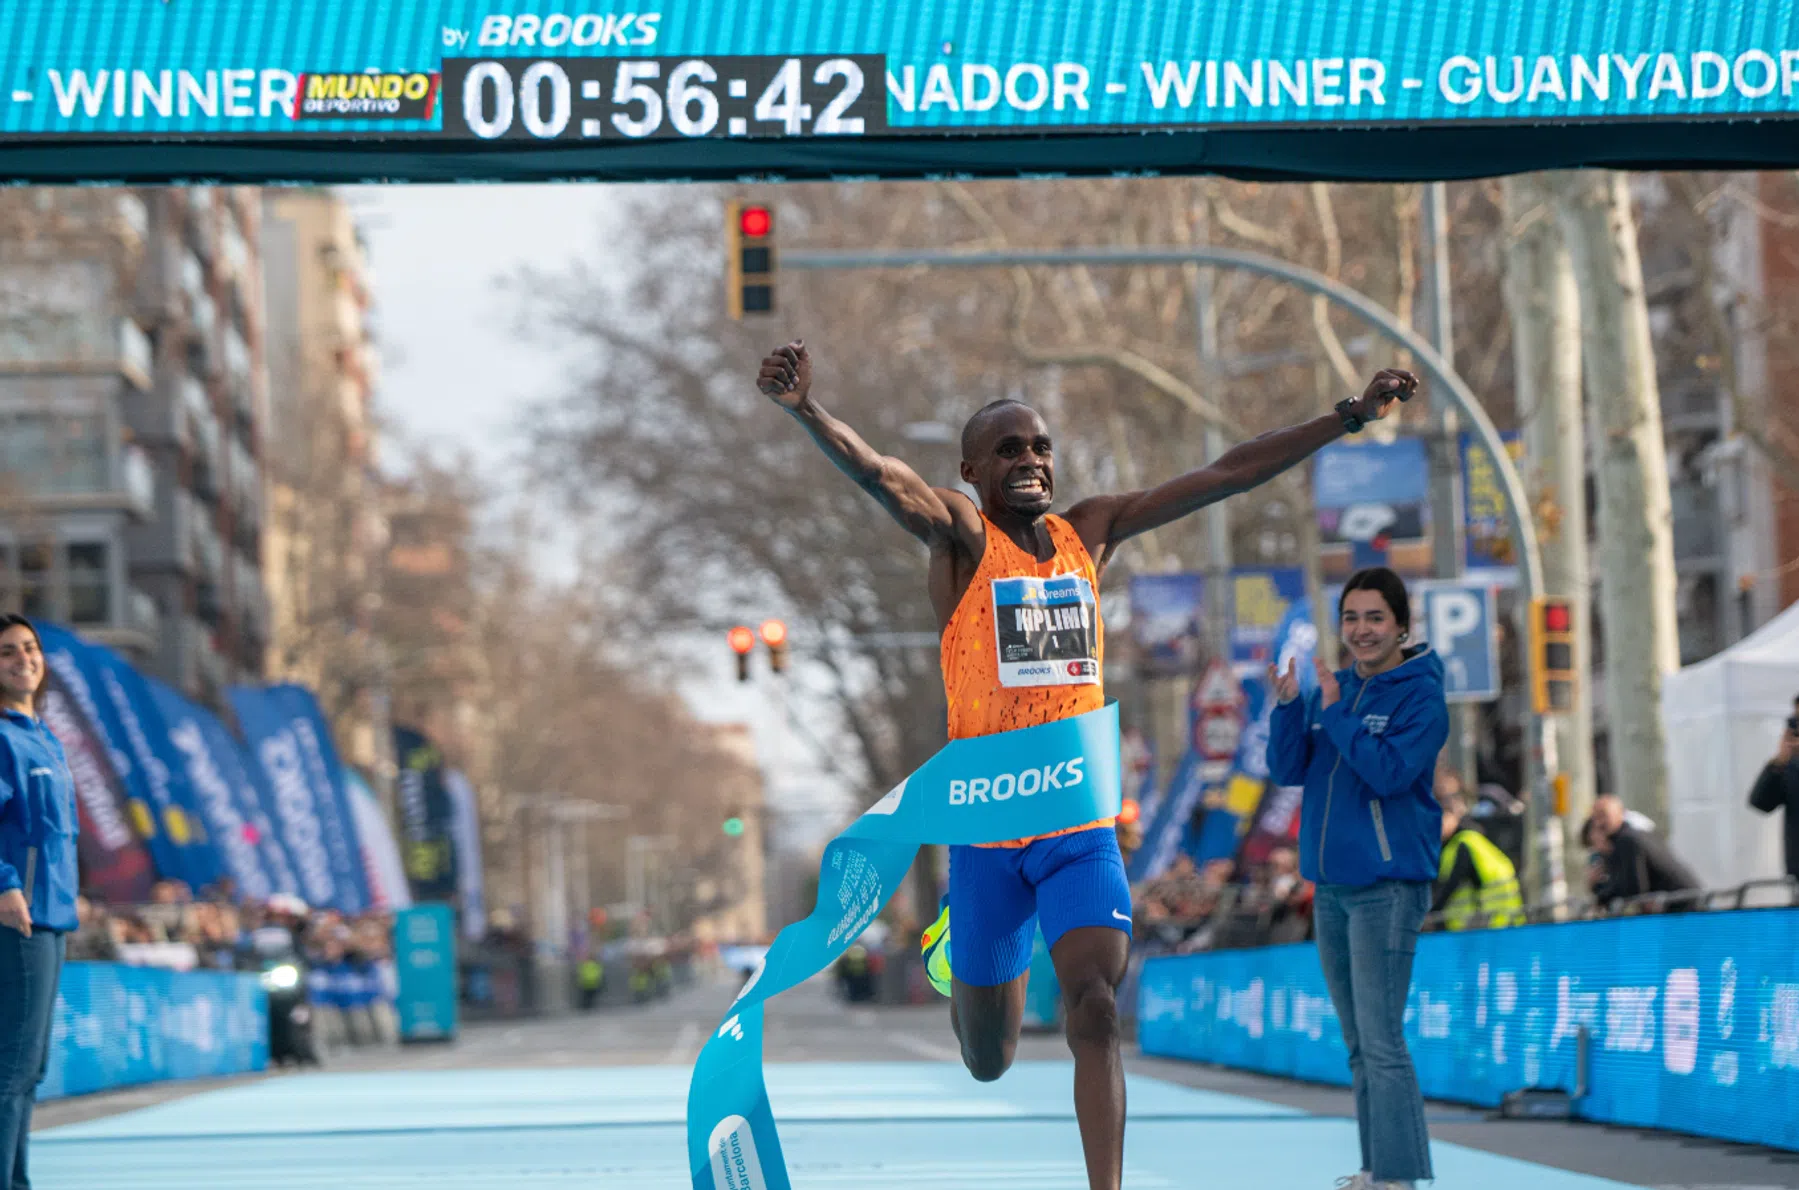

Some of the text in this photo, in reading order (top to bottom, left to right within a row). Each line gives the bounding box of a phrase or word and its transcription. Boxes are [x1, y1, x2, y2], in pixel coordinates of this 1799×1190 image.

[442, 13, 661, 50] by BROOKS
[48, 69, 298, 118] WINNER
[304, 98, 400, 113] DEPORTIVO
[308, 74, 429, 100] MUNDO
[462, 58, 865, 139] 00:56:42
[1141, 57, 1386, 109] WINNER
[1431, 591, 1482, 654] P
[1018, 667, 1051, 676] BROOKS
[949, 756, 1084, 805] BROOKS
